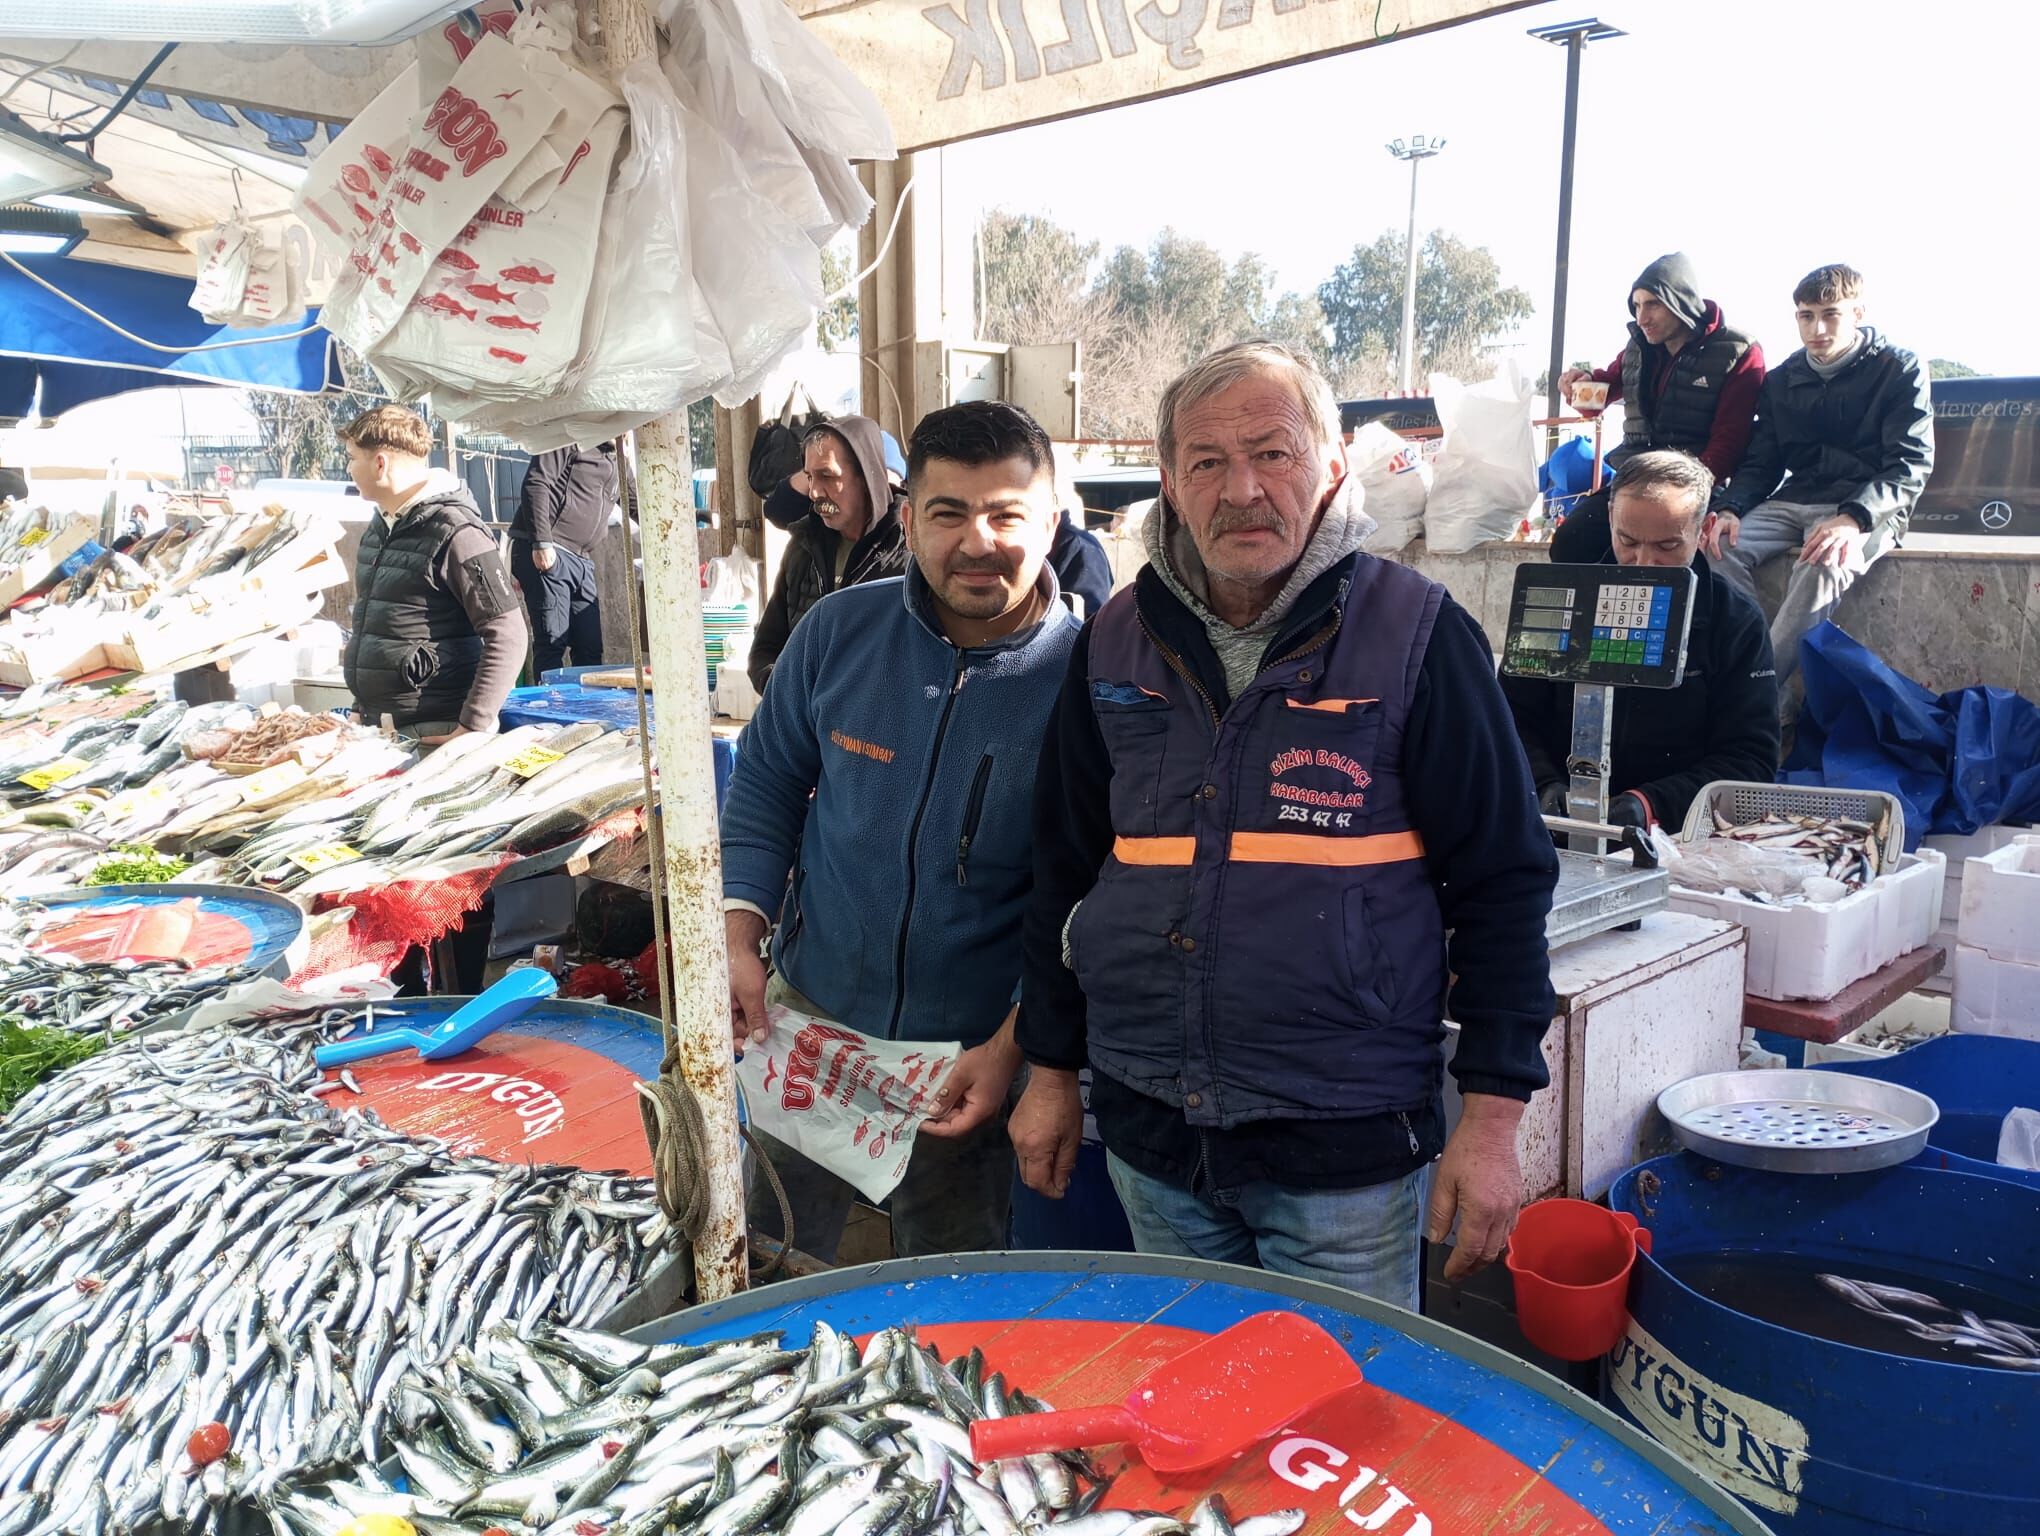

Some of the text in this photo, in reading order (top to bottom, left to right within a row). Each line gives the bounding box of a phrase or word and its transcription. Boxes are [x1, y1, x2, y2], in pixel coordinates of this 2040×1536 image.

[1605, 587, 1647, 598] 1 2 3
[1602, 601, 1645, 612] 4 5 6
[1600, 614, 1643, 626] 7 8 9
[1615, 629, 1622, 639] 0
[1634, 631, 1641, 639] C
[1270, 747, 1372, 789] BİZİM BALIKÇI
[1270, 782, 1364, 807] KARABAĞLAR
[1278, 805, 1352, 828] 253 47 47
[1610, 1335, 1795, 1488] UYGUN
